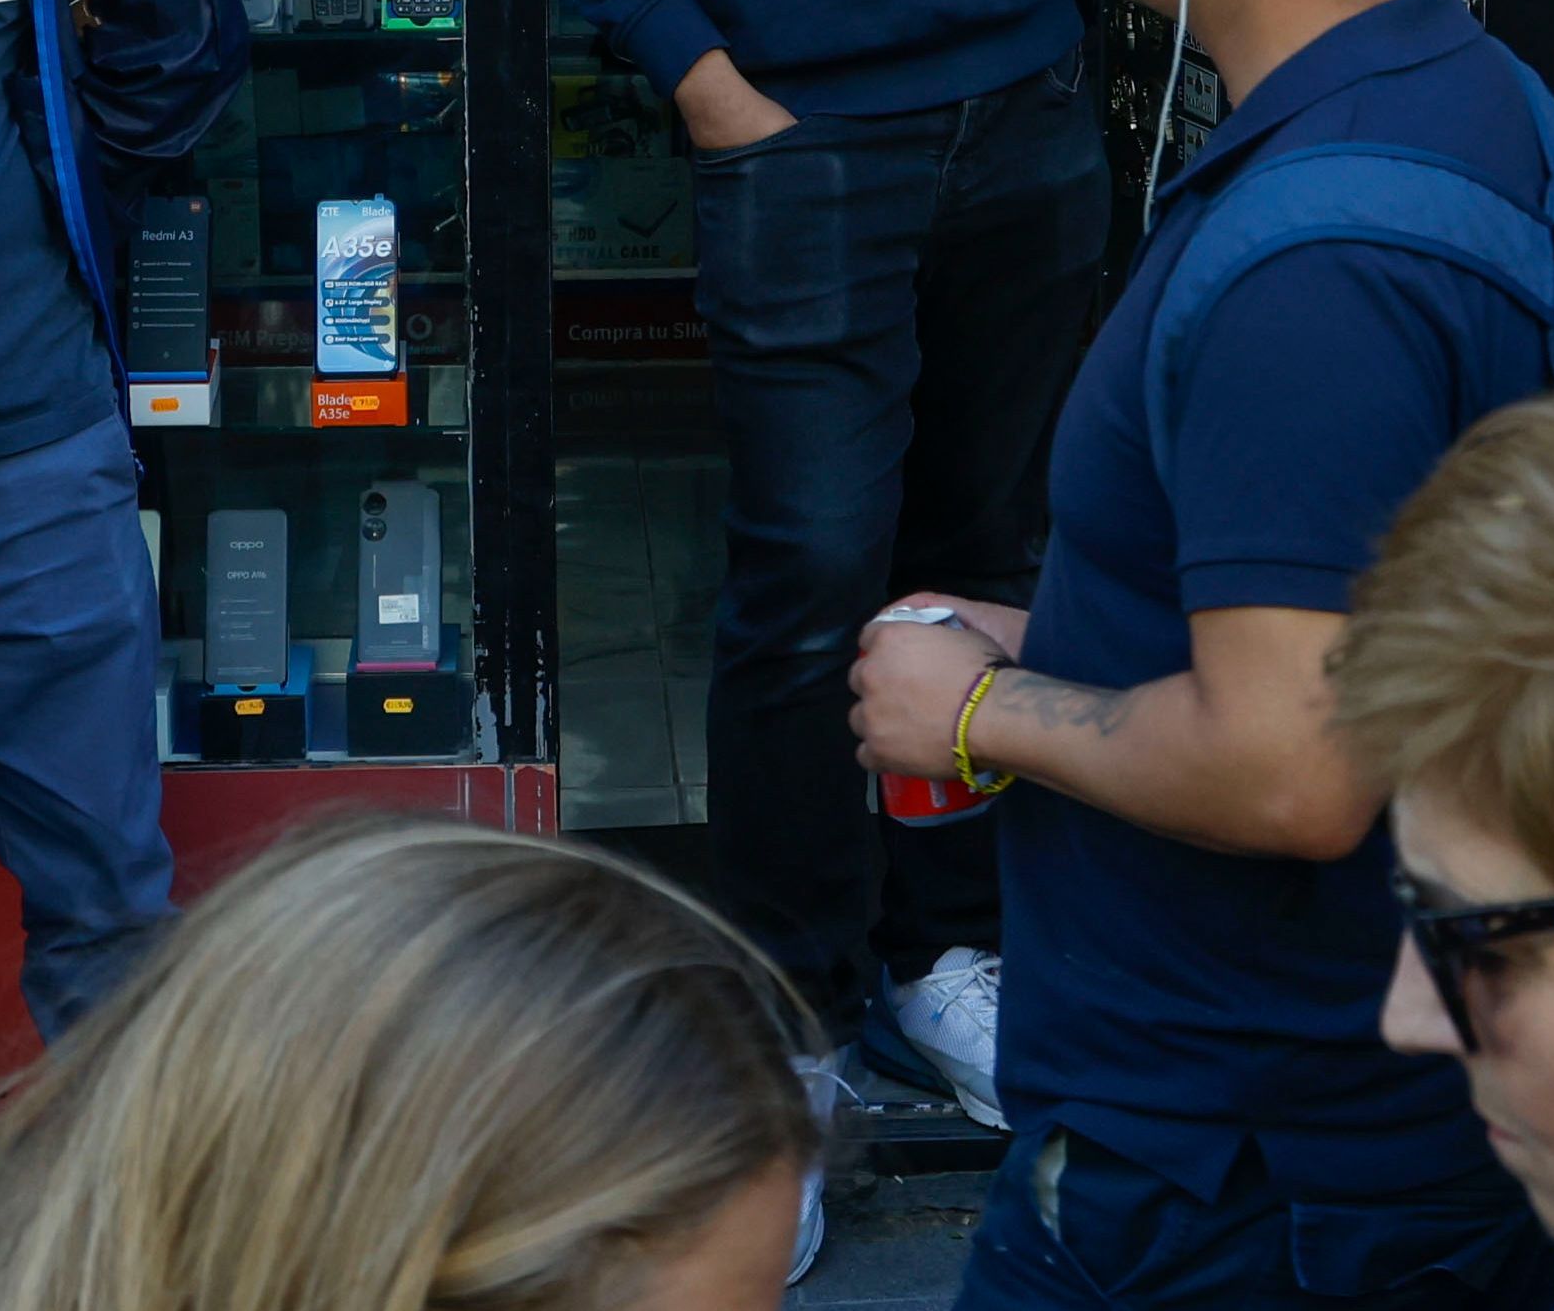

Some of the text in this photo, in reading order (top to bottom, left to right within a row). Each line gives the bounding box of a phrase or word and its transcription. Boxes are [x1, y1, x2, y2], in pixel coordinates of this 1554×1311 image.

[321, 206, 392, 217] ZTE Blade
[142, 230, 194, 241] Redmi A3
[321, 235, 392, 259] A35e
[620, 245, 661, 259] CASE
[348, 299, 363, 307] Large
[363, 298, 383, 307] Display
[568, 322, 709, 345] Compra tu SIM
[317, 394, 352, 407] Blade
[318, 408, 350, 420] A35e
[229, 540, 264, 551] oppo
[227, 571, 249, 580] OPPO
